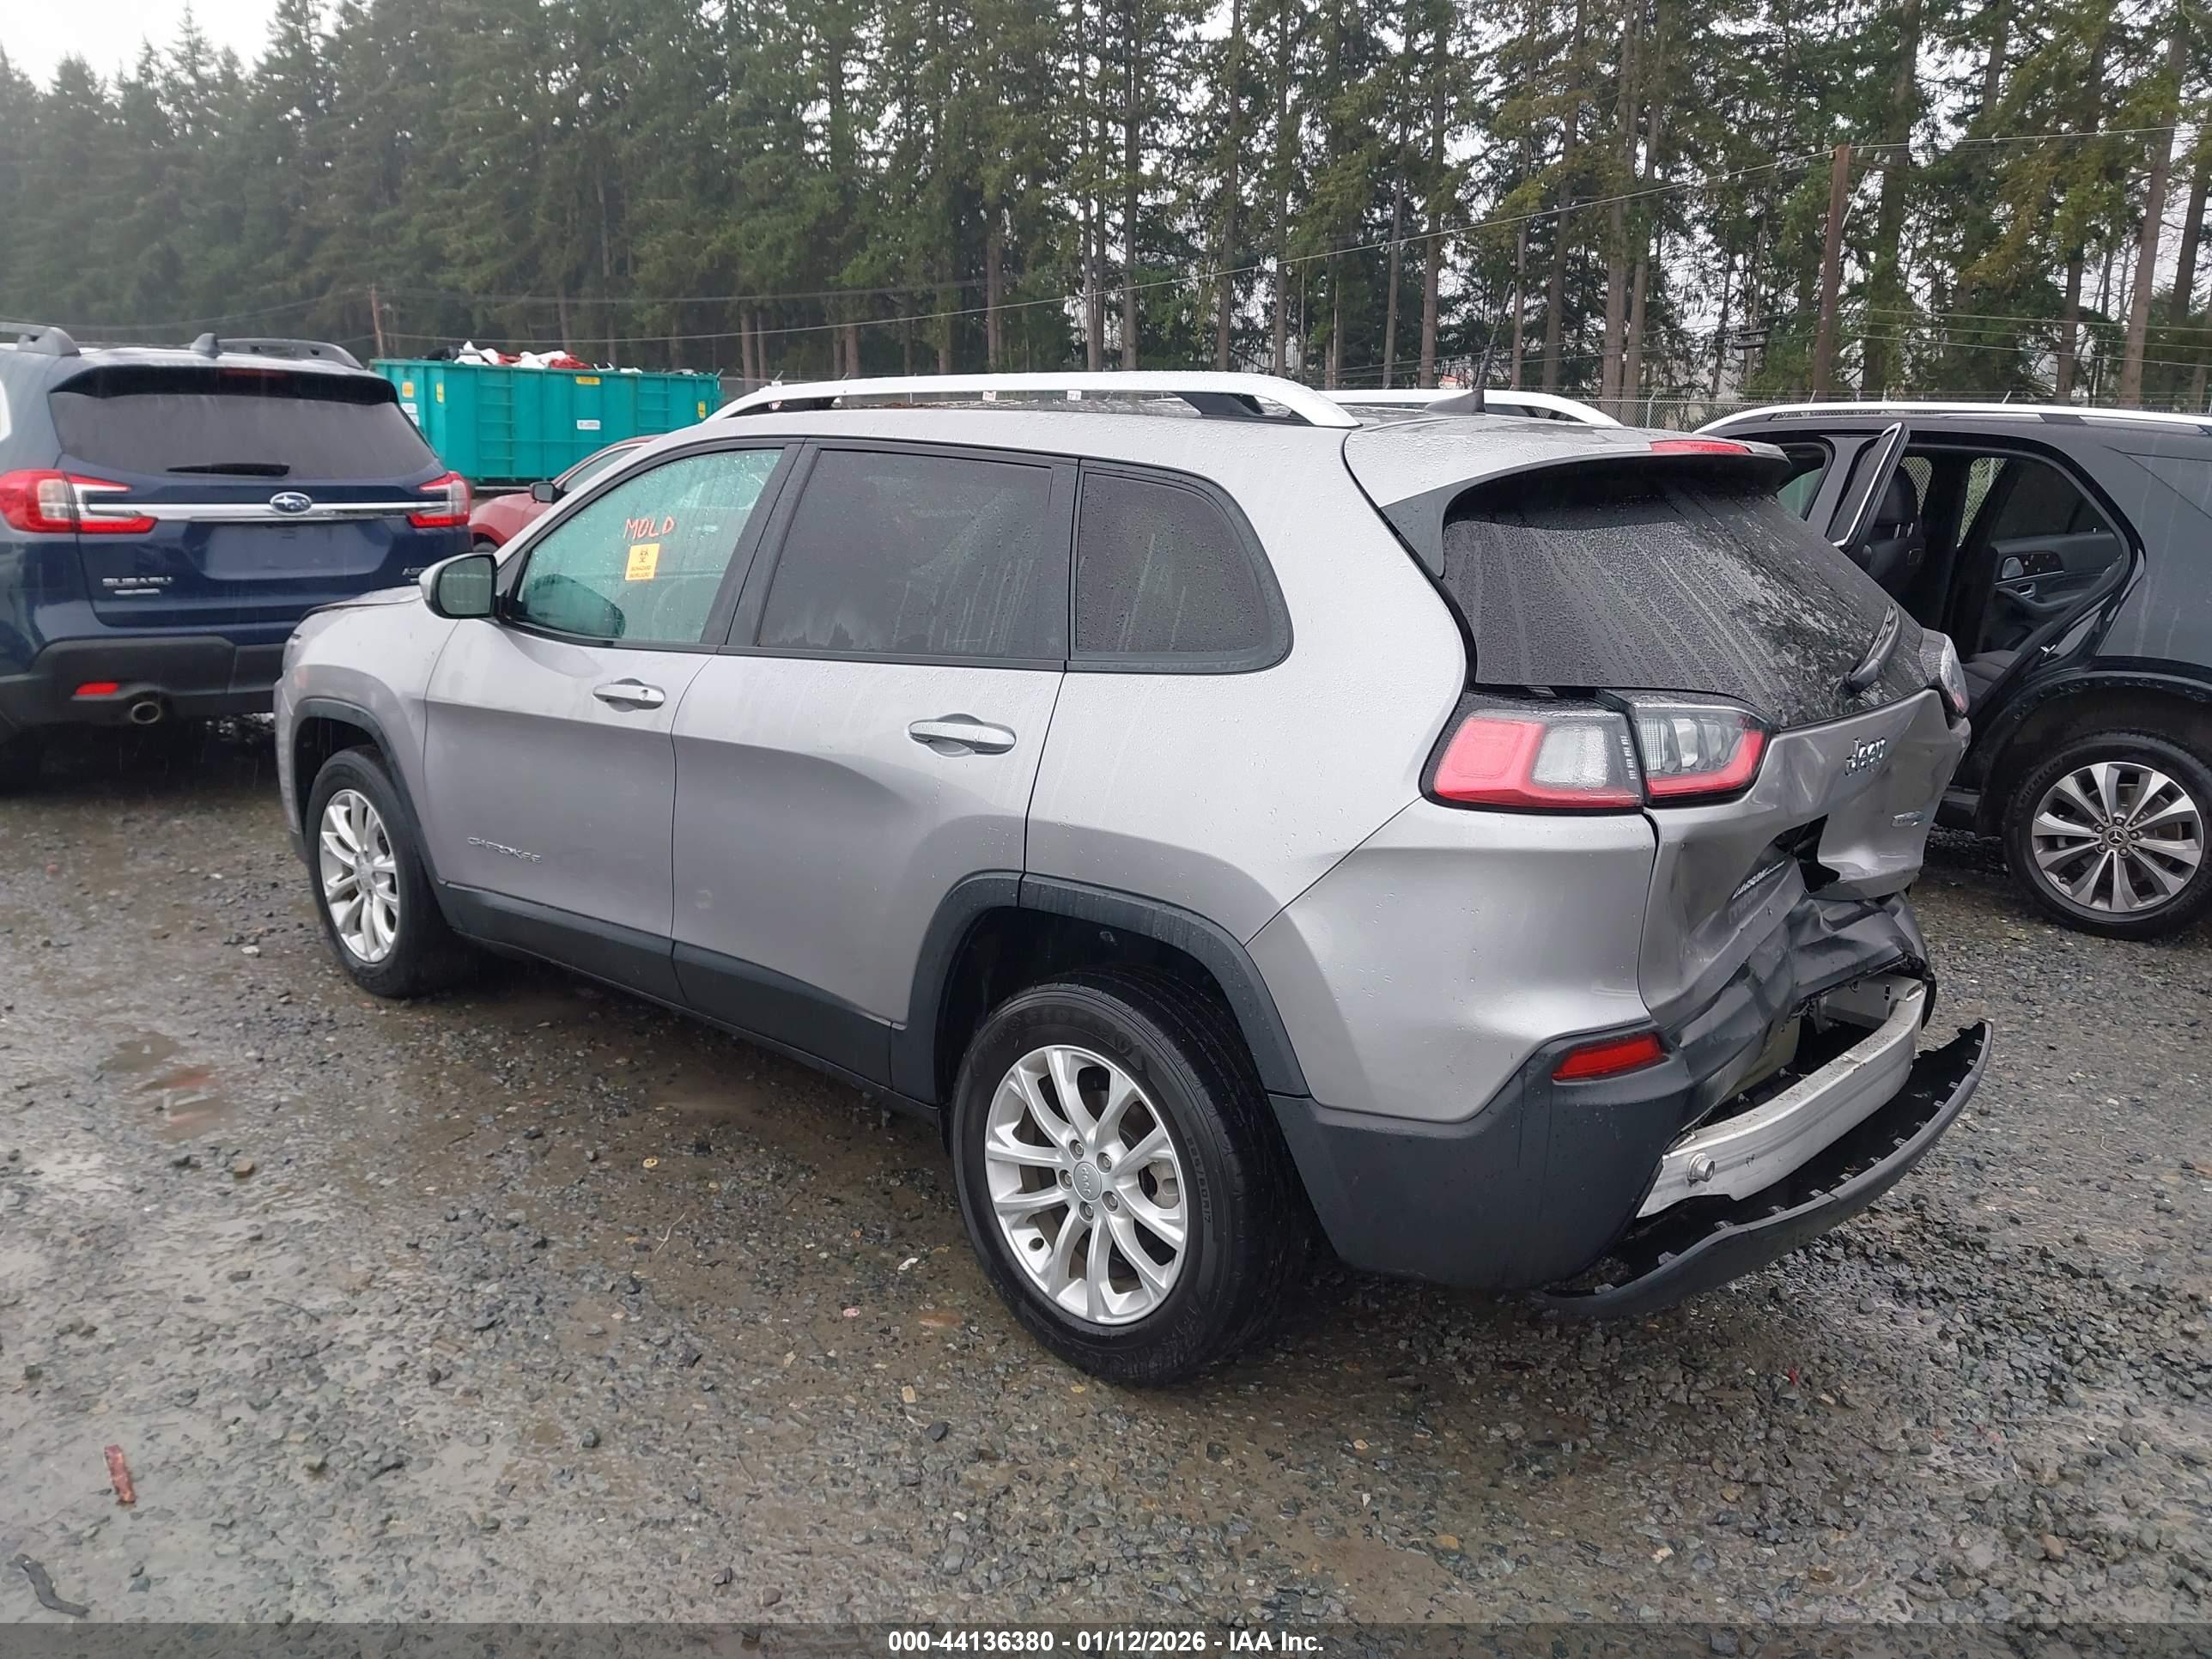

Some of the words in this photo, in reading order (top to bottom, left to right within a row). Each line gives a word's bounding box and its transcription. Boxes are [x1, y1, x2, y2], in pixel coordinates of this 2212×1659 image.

[623, 516, 674, 539] MOLD
[102, 576, 173, 586] SUBARU
[1845, 738, 1887, 776] Jeep
[466, 836, 543, 863] CHEROKEE
